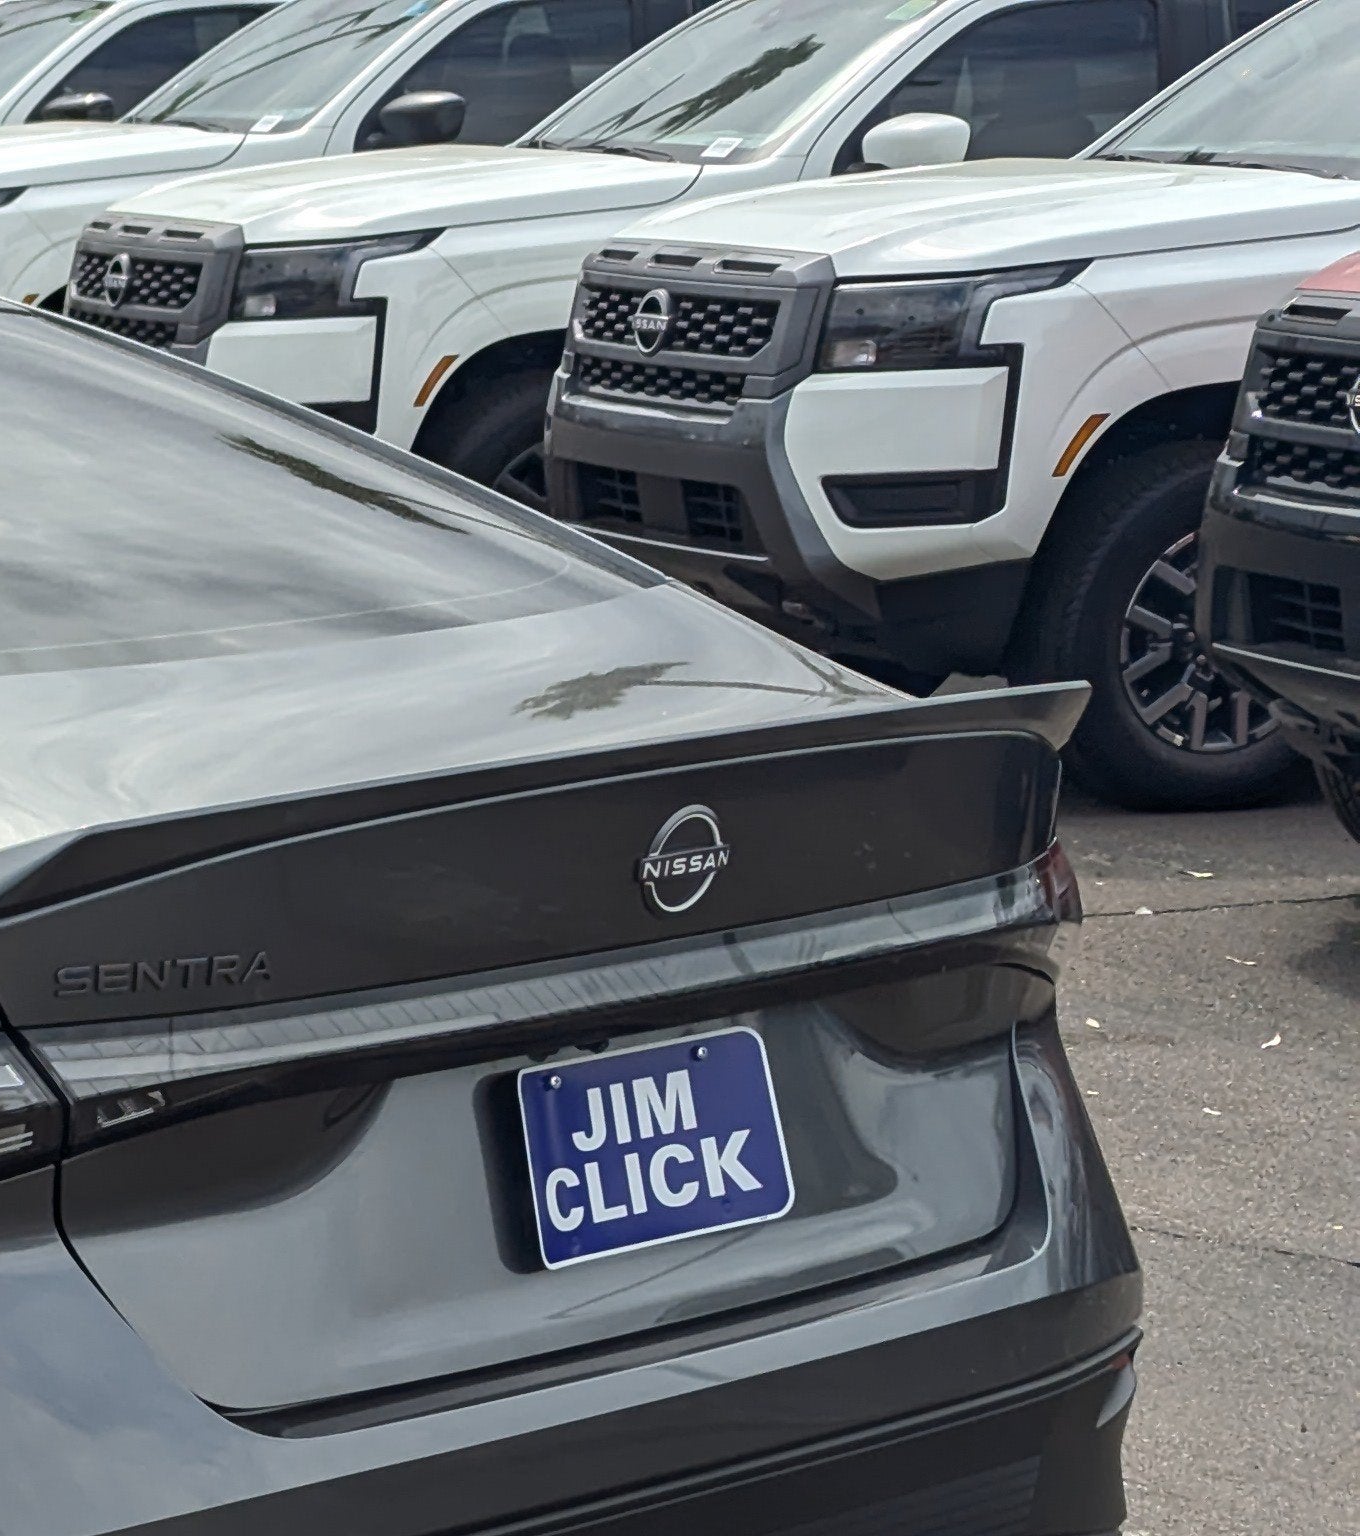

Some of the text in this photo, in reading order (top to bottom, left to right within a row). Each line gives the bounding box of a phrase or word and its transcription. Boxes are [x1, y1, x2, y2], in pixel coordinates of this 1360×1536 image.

[642, 849, 730, 879] NISSAN
[54, 951, 271, 998] SENTRA
[572, 1069, 698, 1152] JIM
[545, 1128, 764, 1232] CLICK
